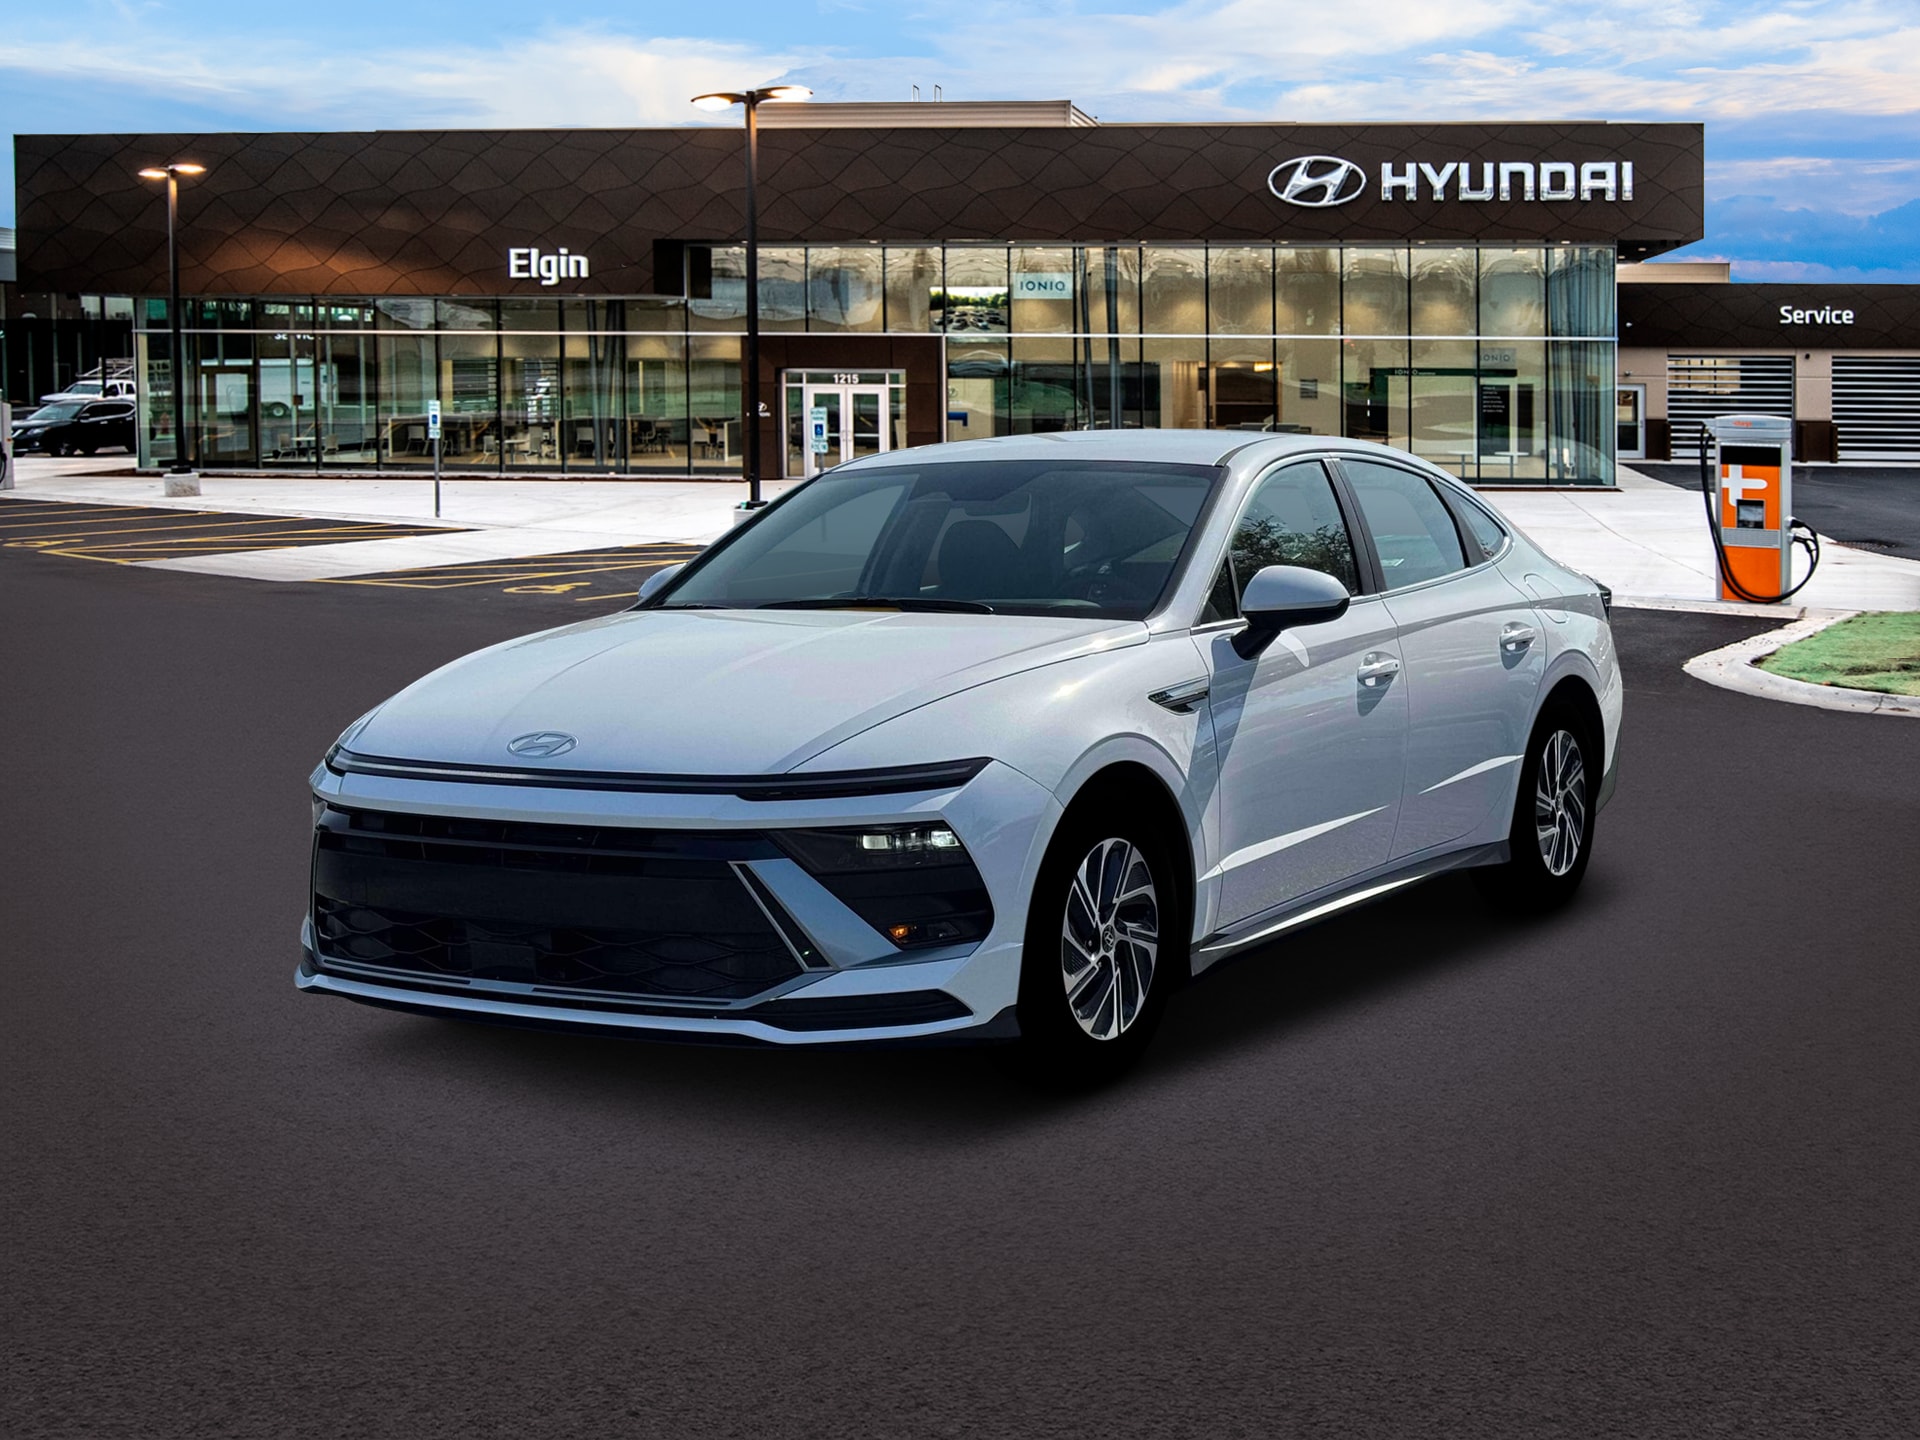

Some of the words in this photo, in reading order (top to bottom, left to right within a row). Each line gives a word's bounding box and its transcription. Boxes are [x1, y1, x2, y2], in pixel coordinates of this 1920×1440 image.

[1380, 161, 1634, 202] HYUNDAI
[508, 247, 590, 286] Elgin
[1020, 280, 1066, 292] IONIQ
[1779, 305, 1855, 325] Service
[833, 373, 860, 385] 1215
